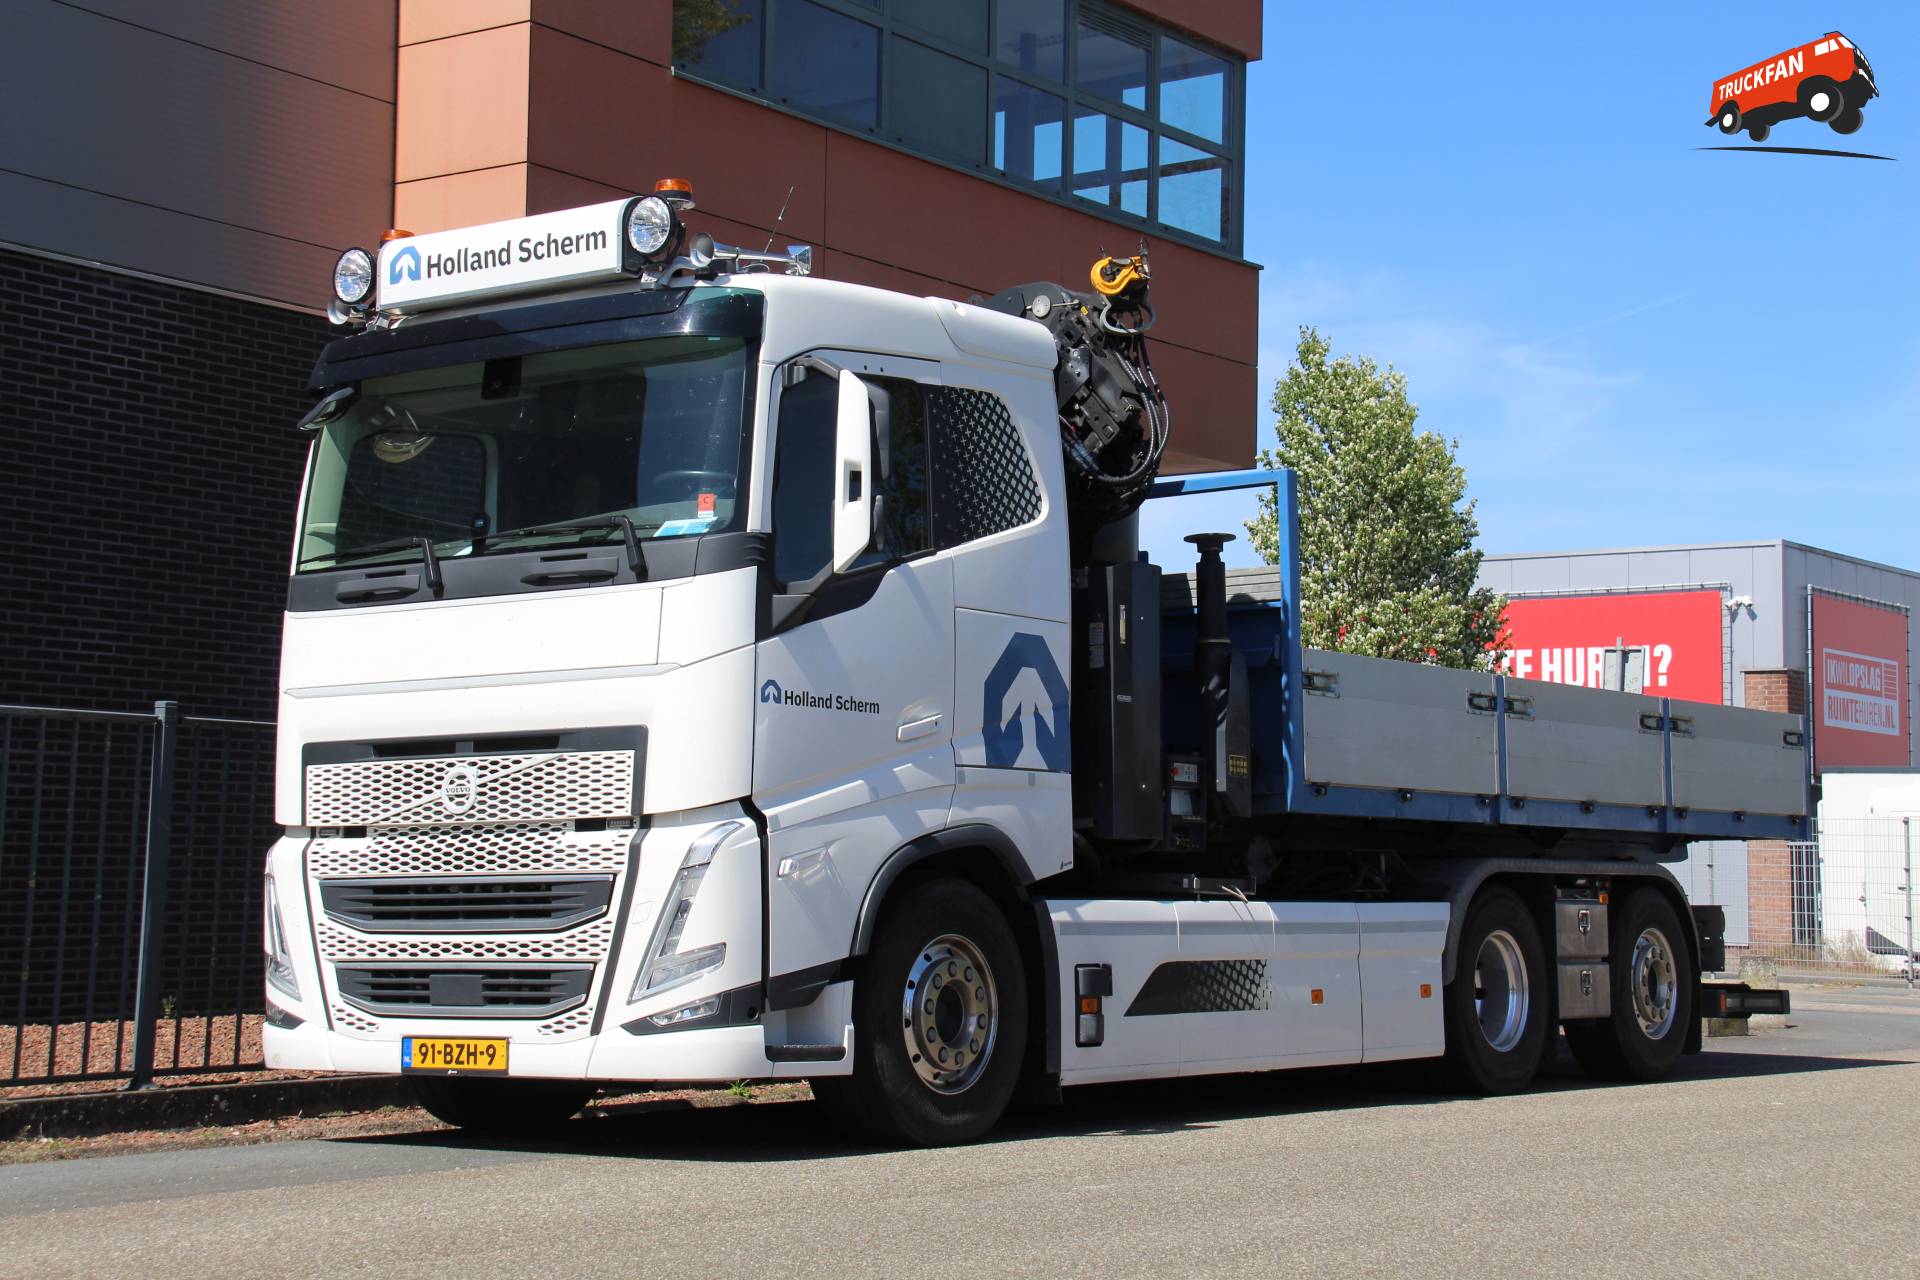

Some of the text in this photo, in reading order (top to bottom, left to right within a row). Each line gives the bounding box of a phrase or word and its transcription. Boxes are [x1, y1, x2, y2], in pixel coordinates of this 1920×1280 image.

[427, 229, 607, 278] Holland Scherm
[1541, 644, 1672, 689] HUR?
[784, 690, 880, 714] Holland Scherm
[418, 1042, 497, 1066] 91-BZH-9
